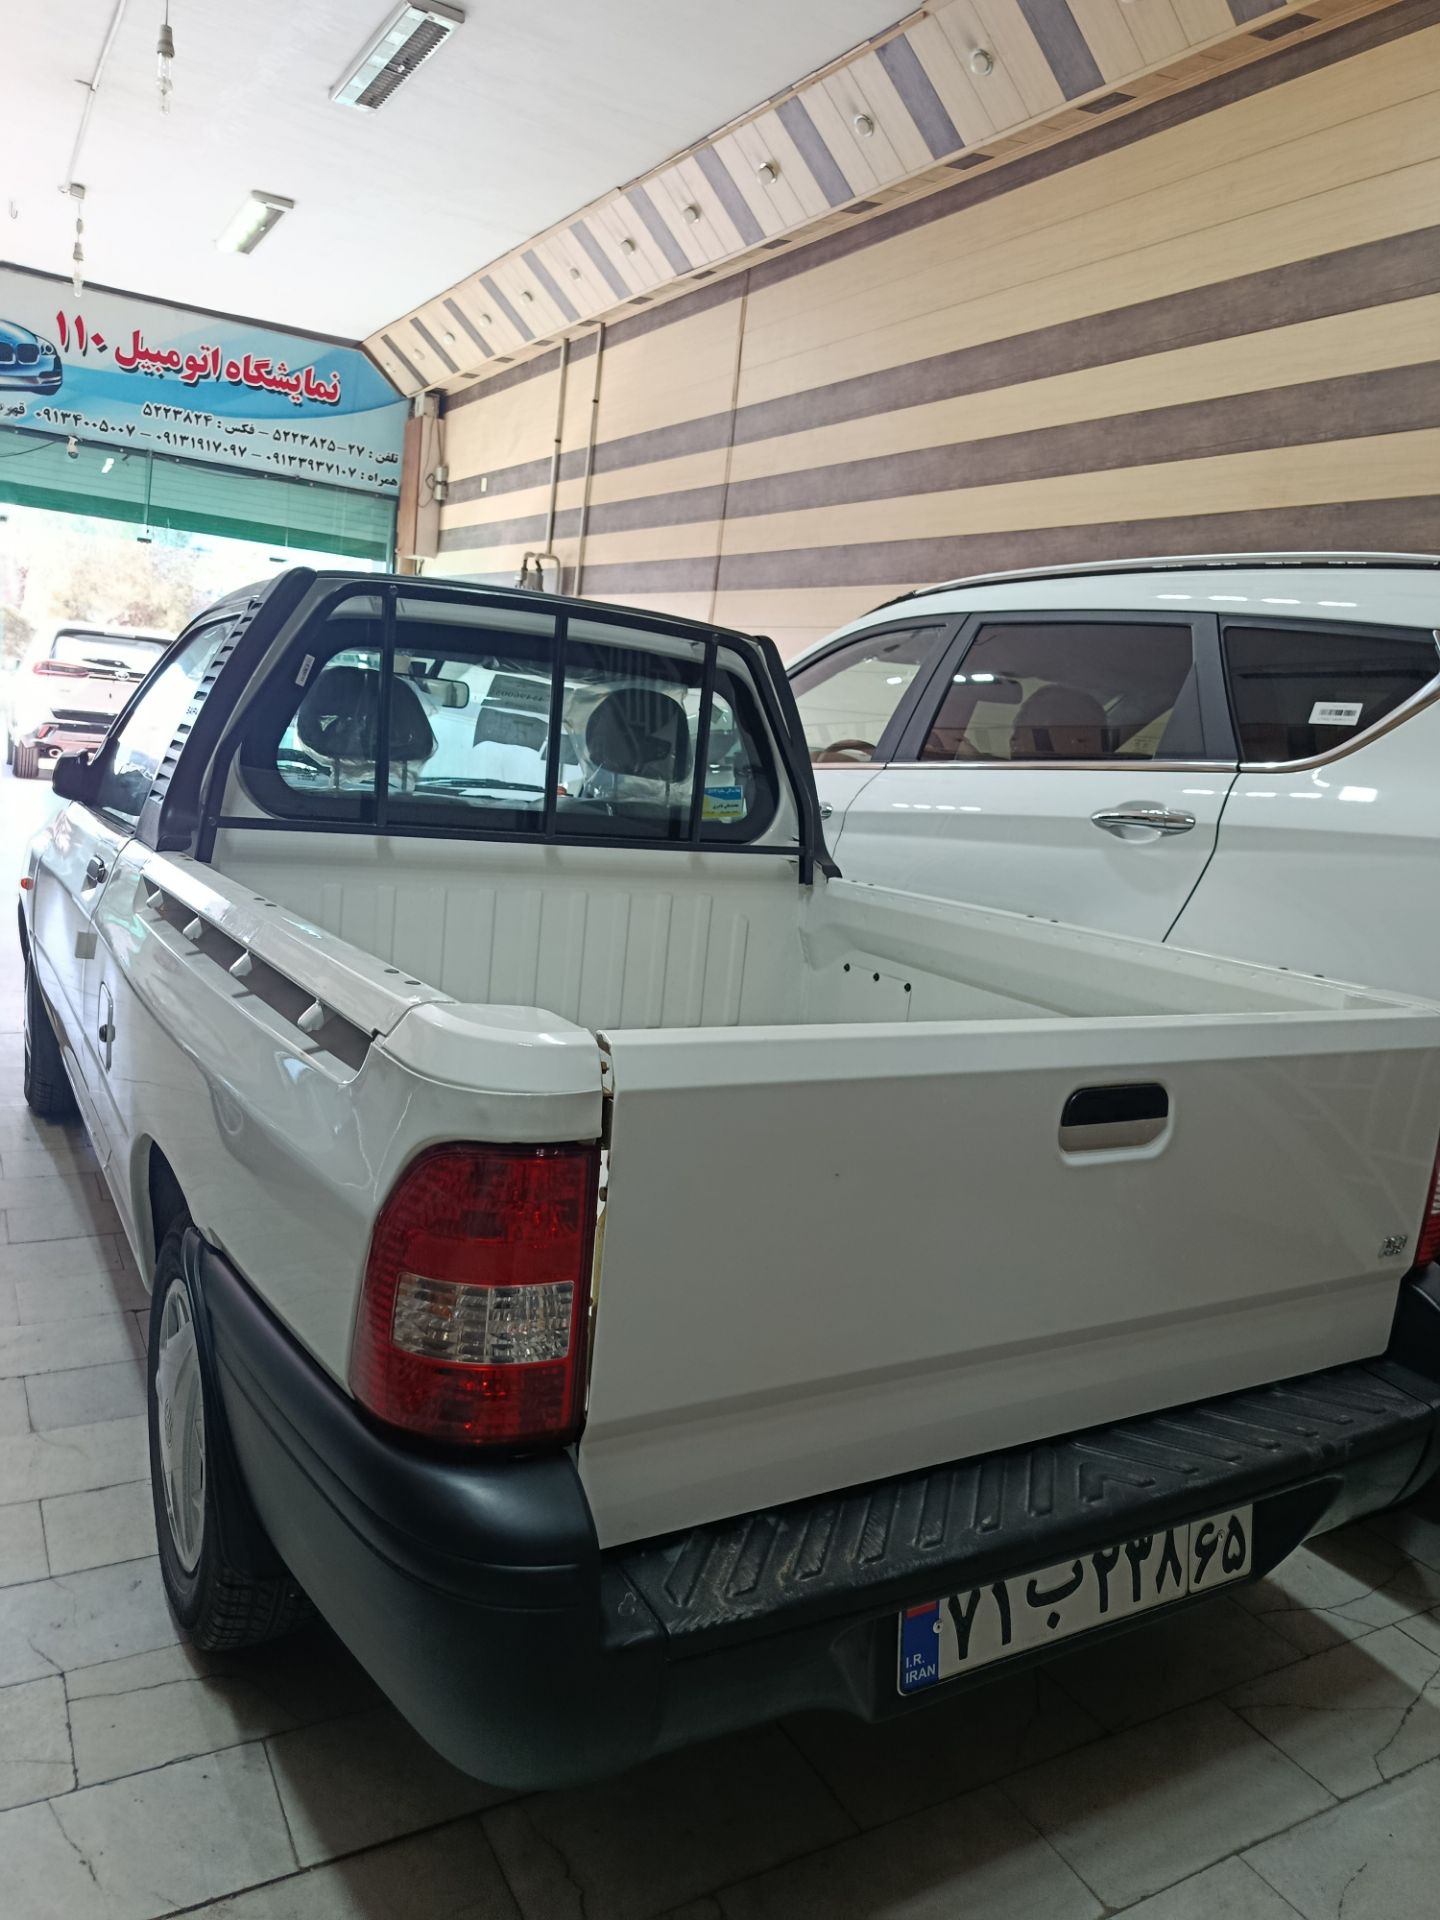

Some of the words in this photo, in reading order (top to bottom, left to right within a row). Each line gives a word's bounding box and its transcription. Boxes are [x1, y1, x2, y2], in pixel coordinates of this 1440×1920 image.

[56, 310, 105, 351] ۱۱۰
[115, 329, 221, 383] اتومبیل
[225, 354, 341, 404] نمایشگاه
[1194, 1513, 1247, 1585] ۶۵
[905, 1653, 926, 1669] I.R.
[905, 1663, 937, 1684] IRAN
